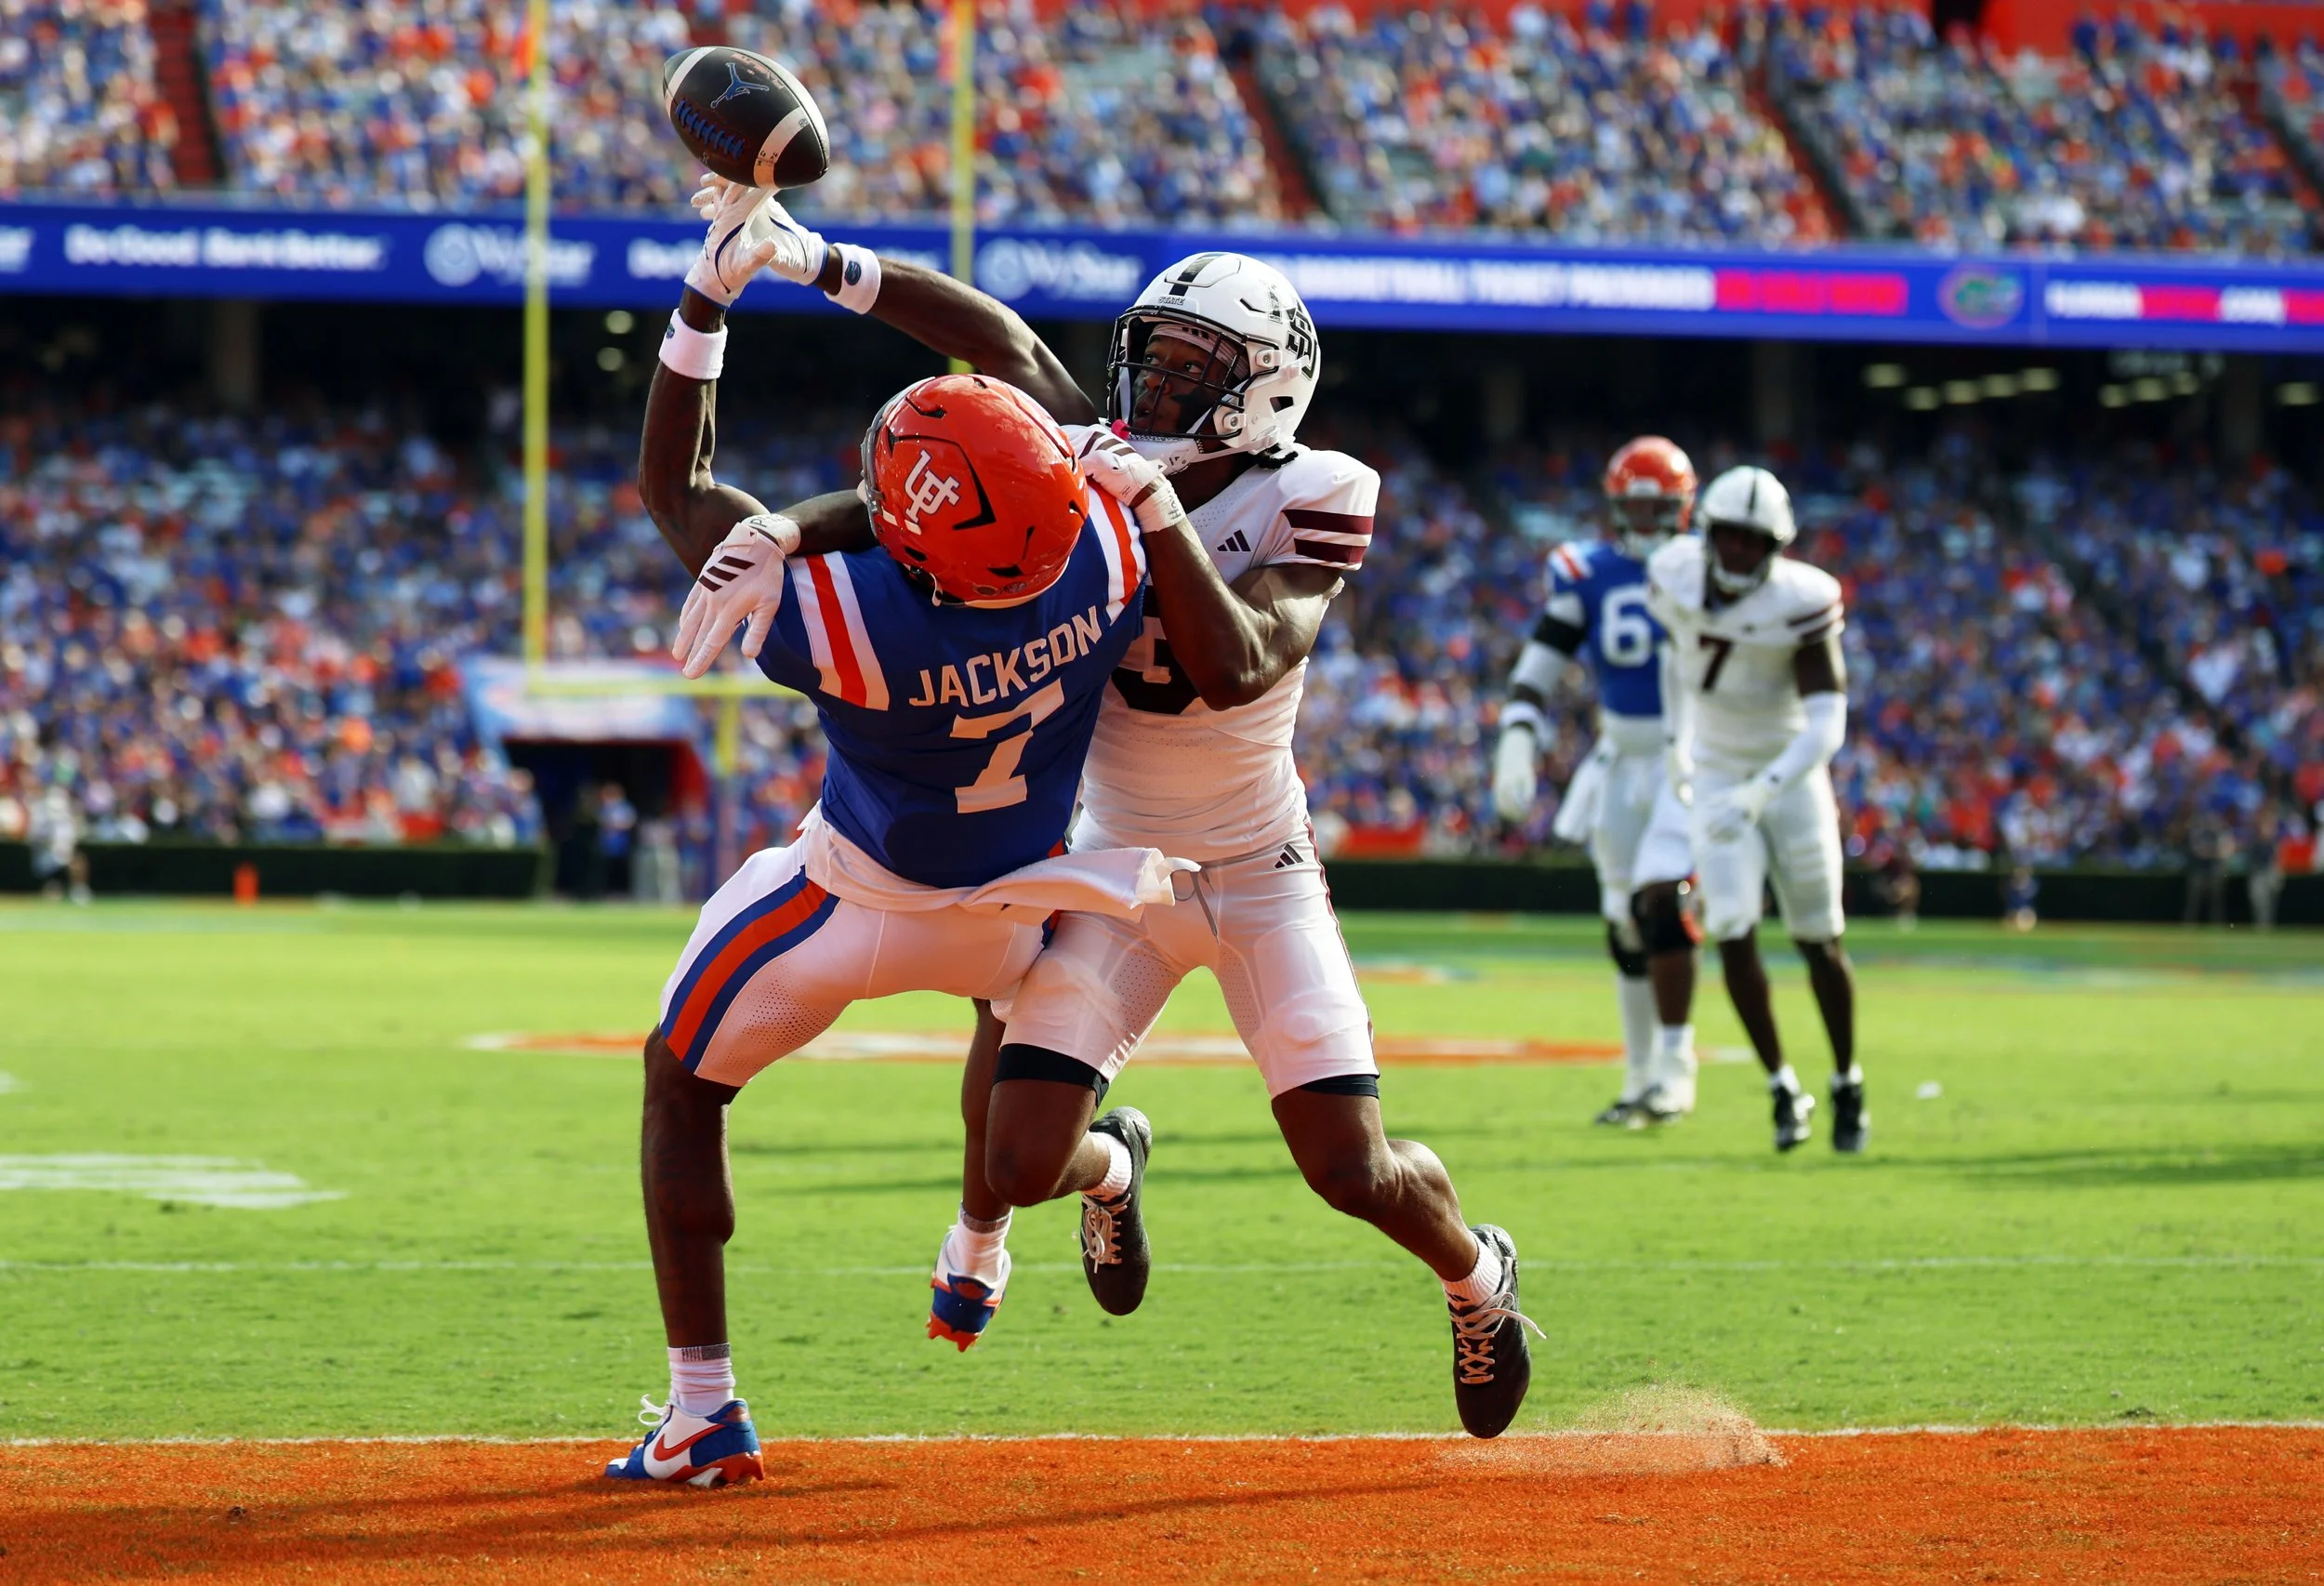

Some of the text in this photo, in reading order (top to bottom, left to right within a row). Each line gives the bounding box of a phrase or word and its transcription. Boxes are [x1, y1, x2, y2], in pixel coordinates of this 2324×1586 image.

[908, 604, 1103, 708] JACKSON
[1698, 635, 1734, 692] 7
[949, 677, 1065, 814] 7
